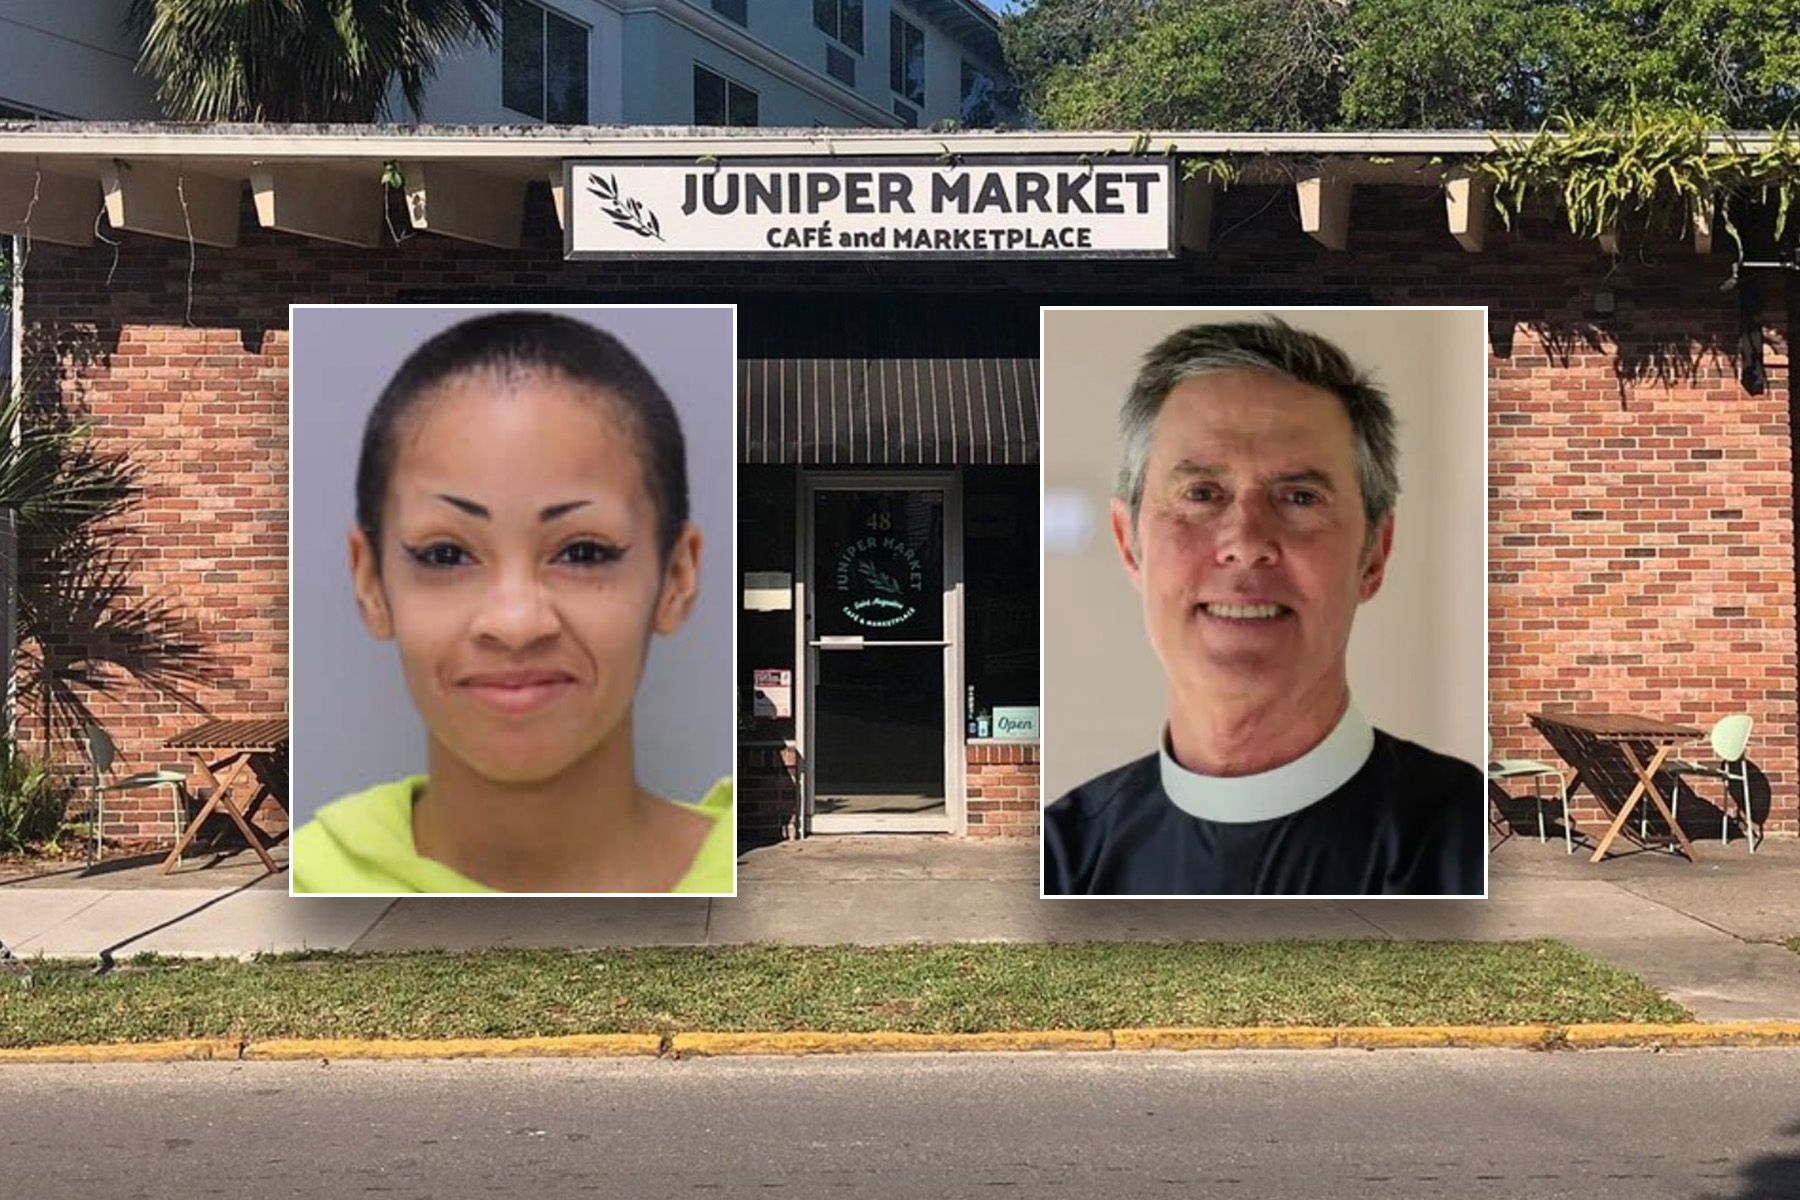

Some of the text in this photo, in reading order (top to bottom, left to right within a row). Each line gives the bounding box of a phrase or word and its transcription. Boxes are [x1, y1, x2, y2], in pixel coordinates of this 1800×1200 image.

[681, 172, 1161, 216] JUNIPER MARKET
[766, 220, 1092, 251] CAFÉ and MARKETPLACE
[866, 511, 892, 530] 48
[837, 536, 922, 591] JUNIPER MARKET
[998, 716, 1033, 733] Open
